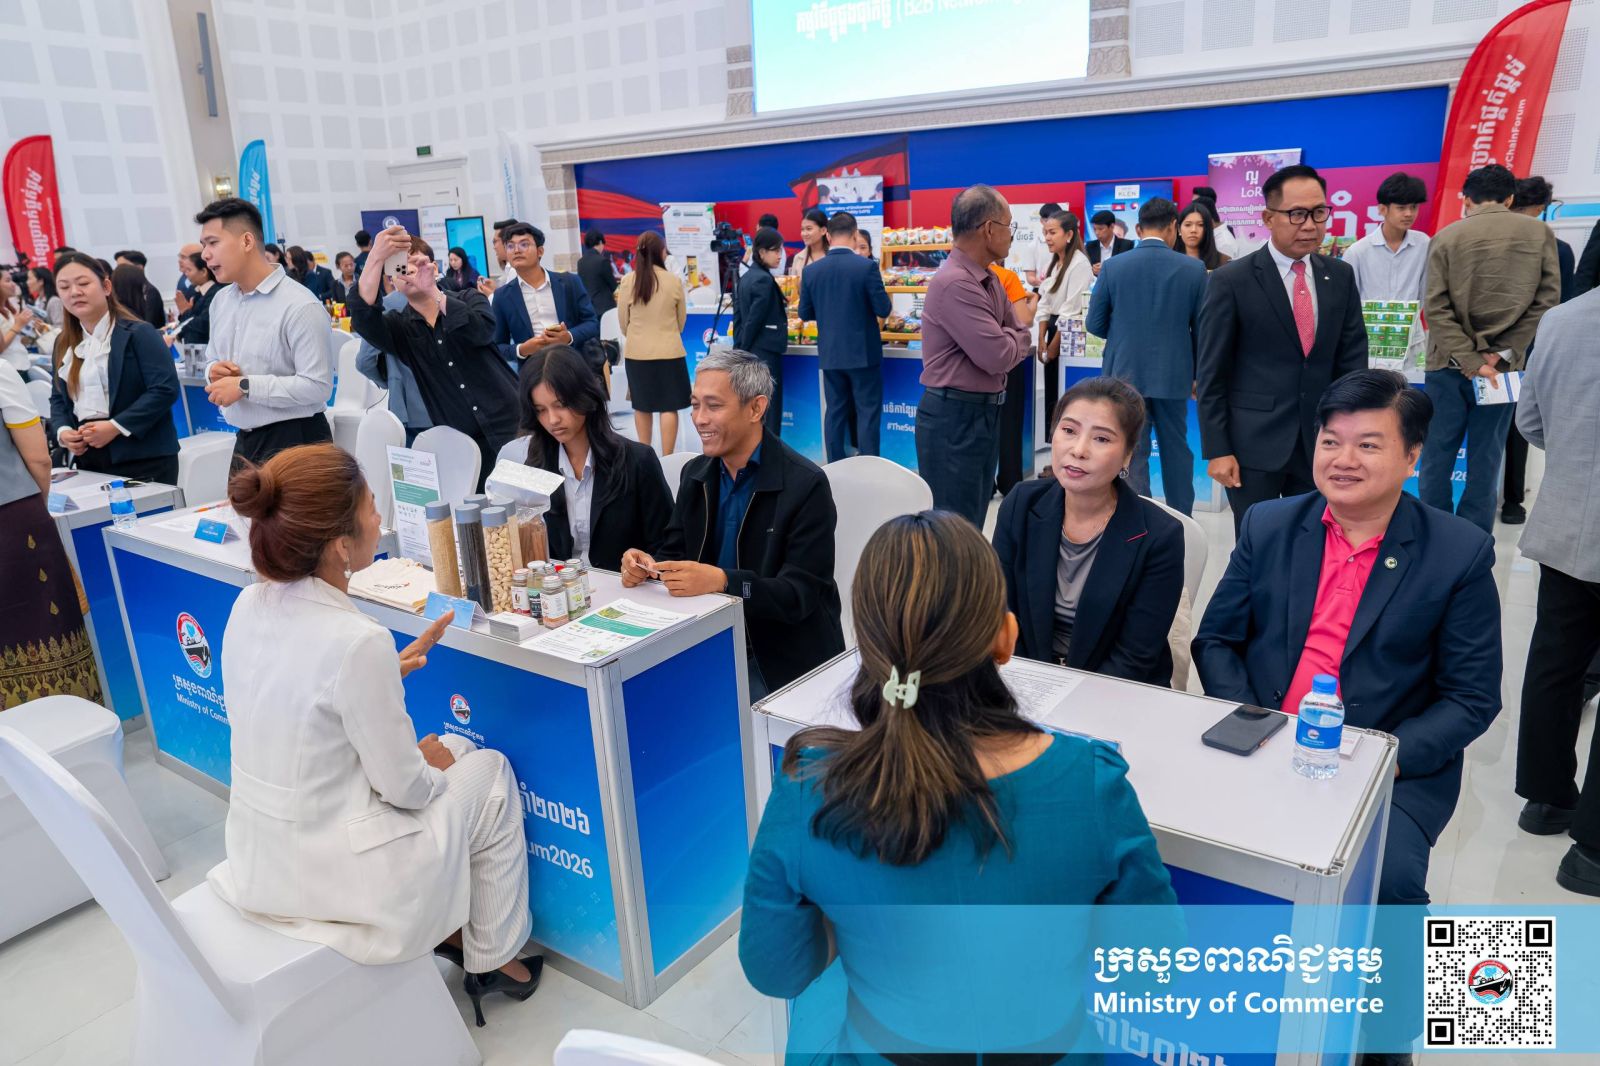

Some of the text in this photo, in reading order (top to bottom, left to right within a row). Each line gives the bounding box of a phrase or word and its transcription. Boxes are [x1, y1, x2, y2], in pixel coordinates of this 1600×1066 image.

[176, 692, 201, 714] Ministry
[202, 705, 209, 716] of
[526, 842, 594, 879] um2026
